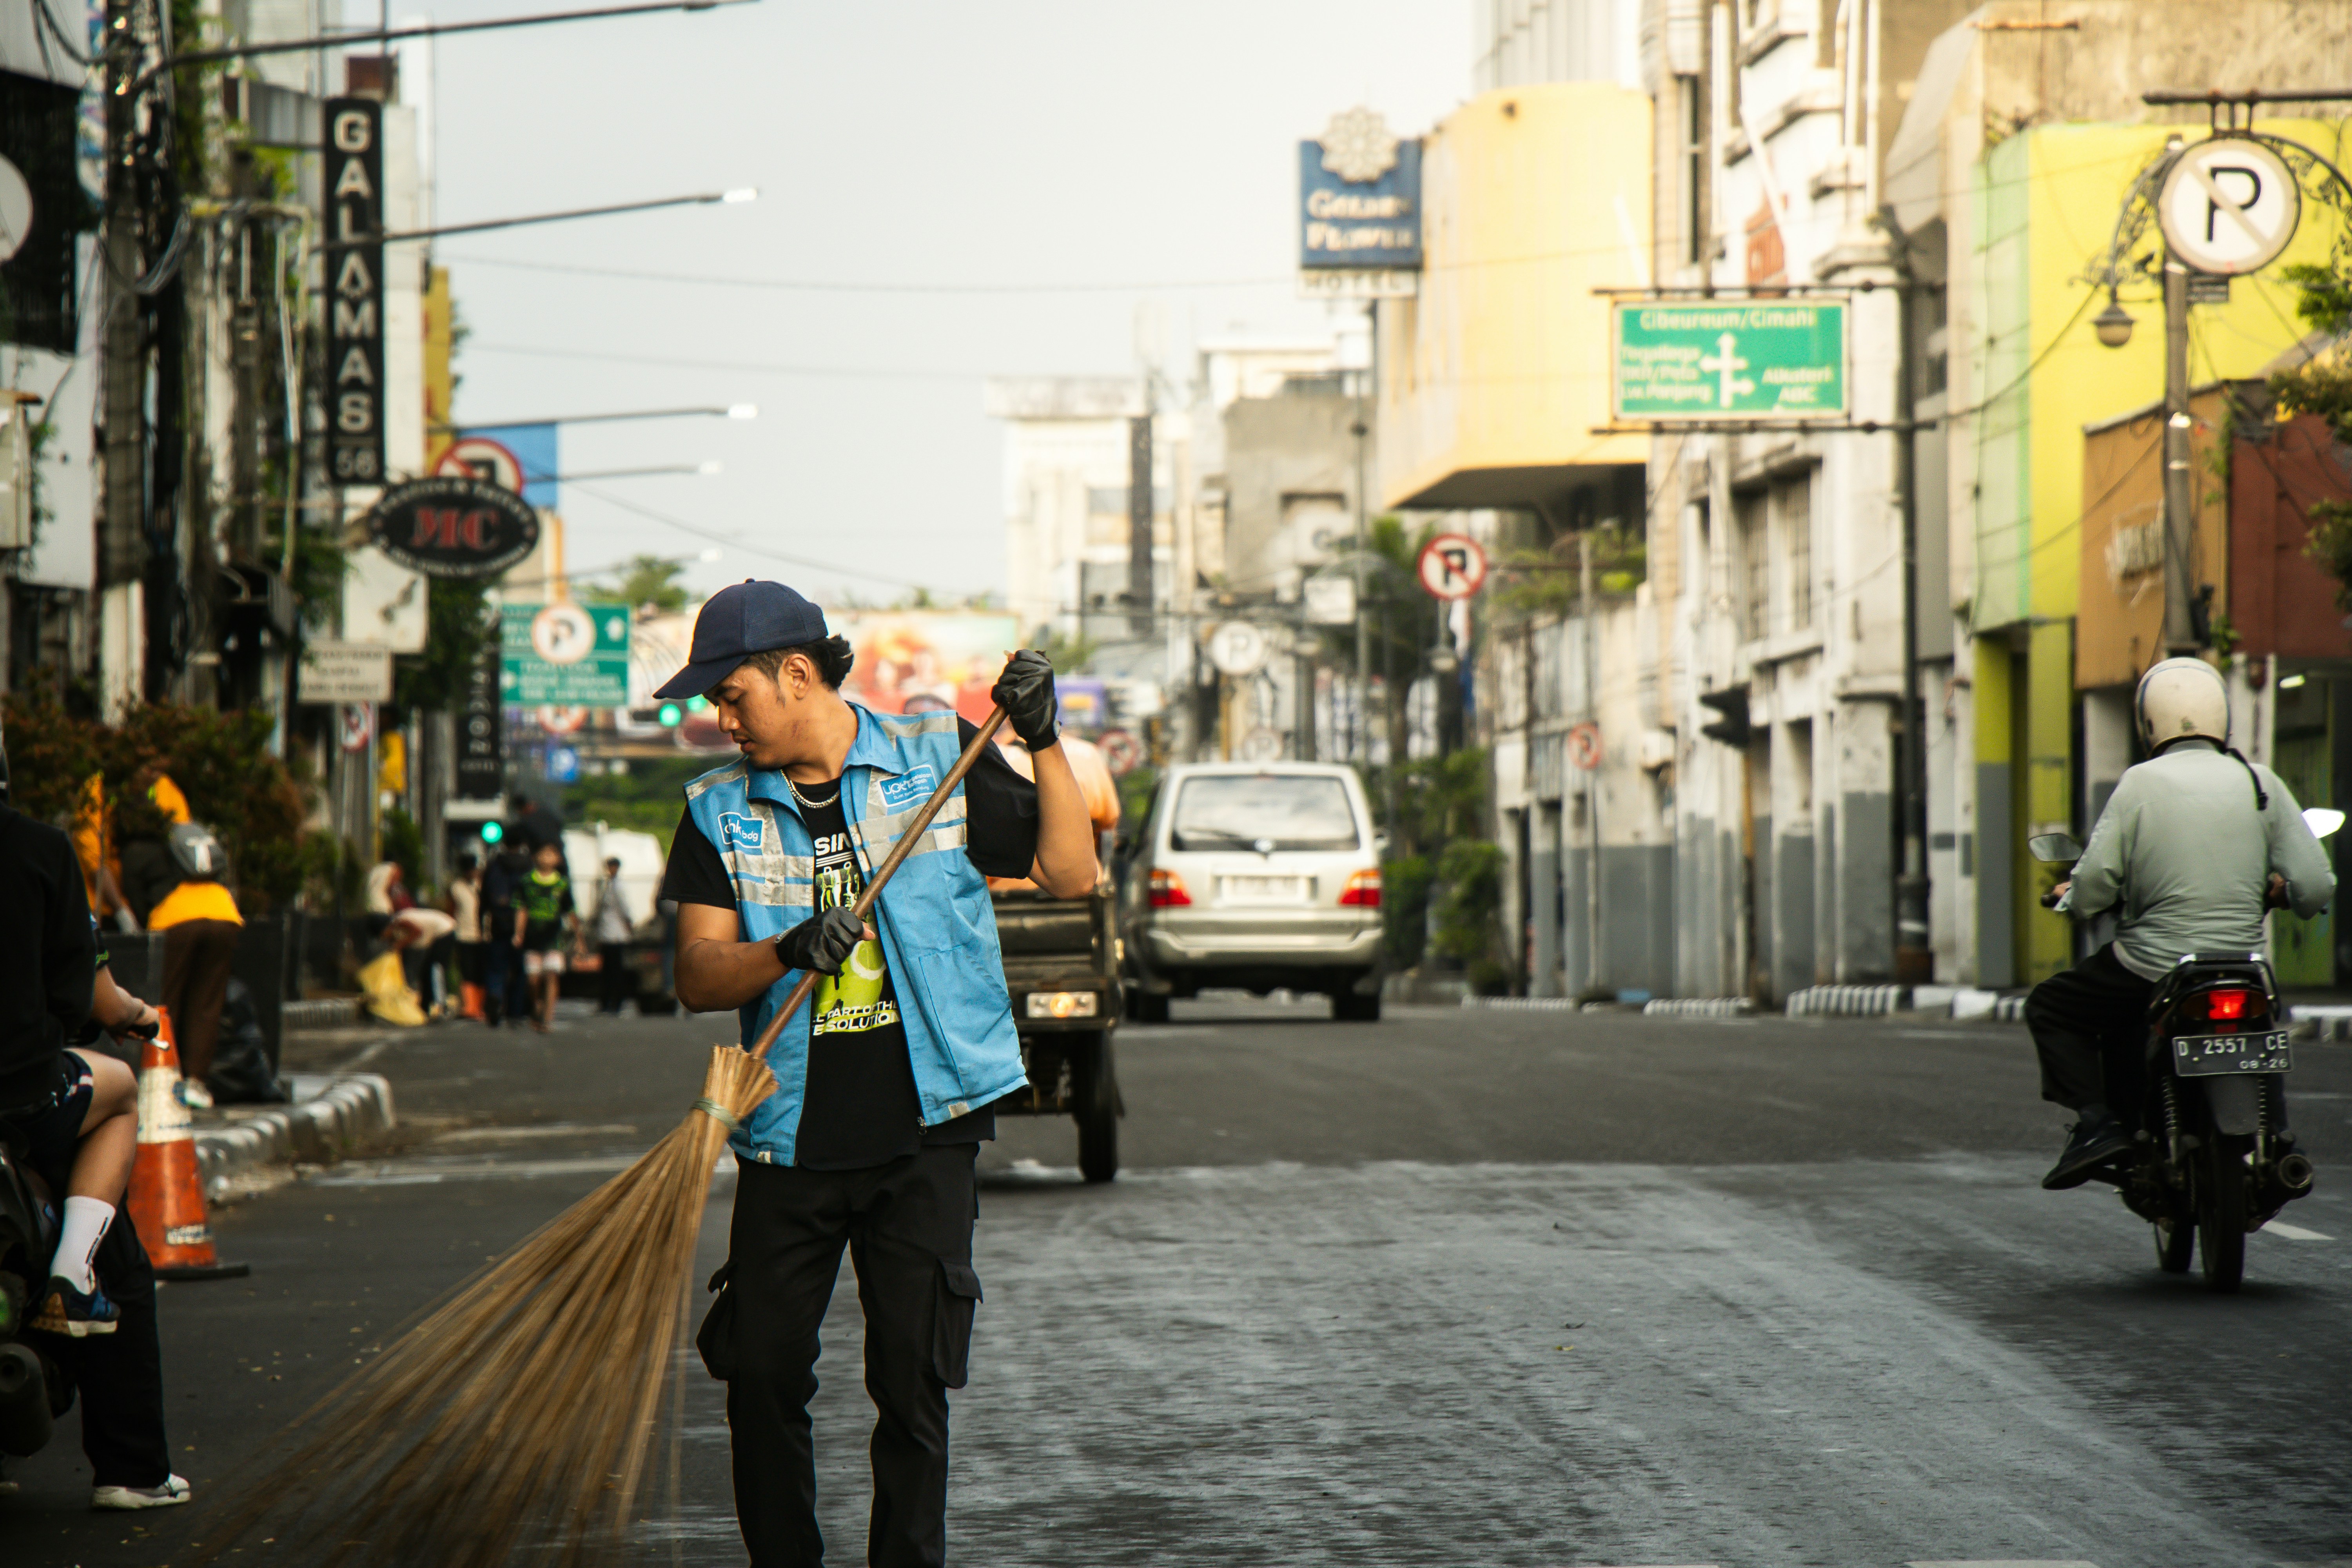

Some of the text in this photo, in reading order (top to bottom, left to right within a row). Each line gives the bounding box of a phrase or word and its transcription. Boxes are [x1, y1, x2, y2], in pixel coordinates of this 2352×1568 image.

[2208, 166, 2261, 241] P
[333, 109, 378, 432] GALAMAS
[408, 506, 501, 552] MC
[1443, 548, 1466, 586] P
[742, 830, 759, 842] bdg
[812, 1011, 900, 1036] ESOLUTION
[2177, 1041, 2189, 1056] D
[2265, 1034, 2288, 1051] CE
